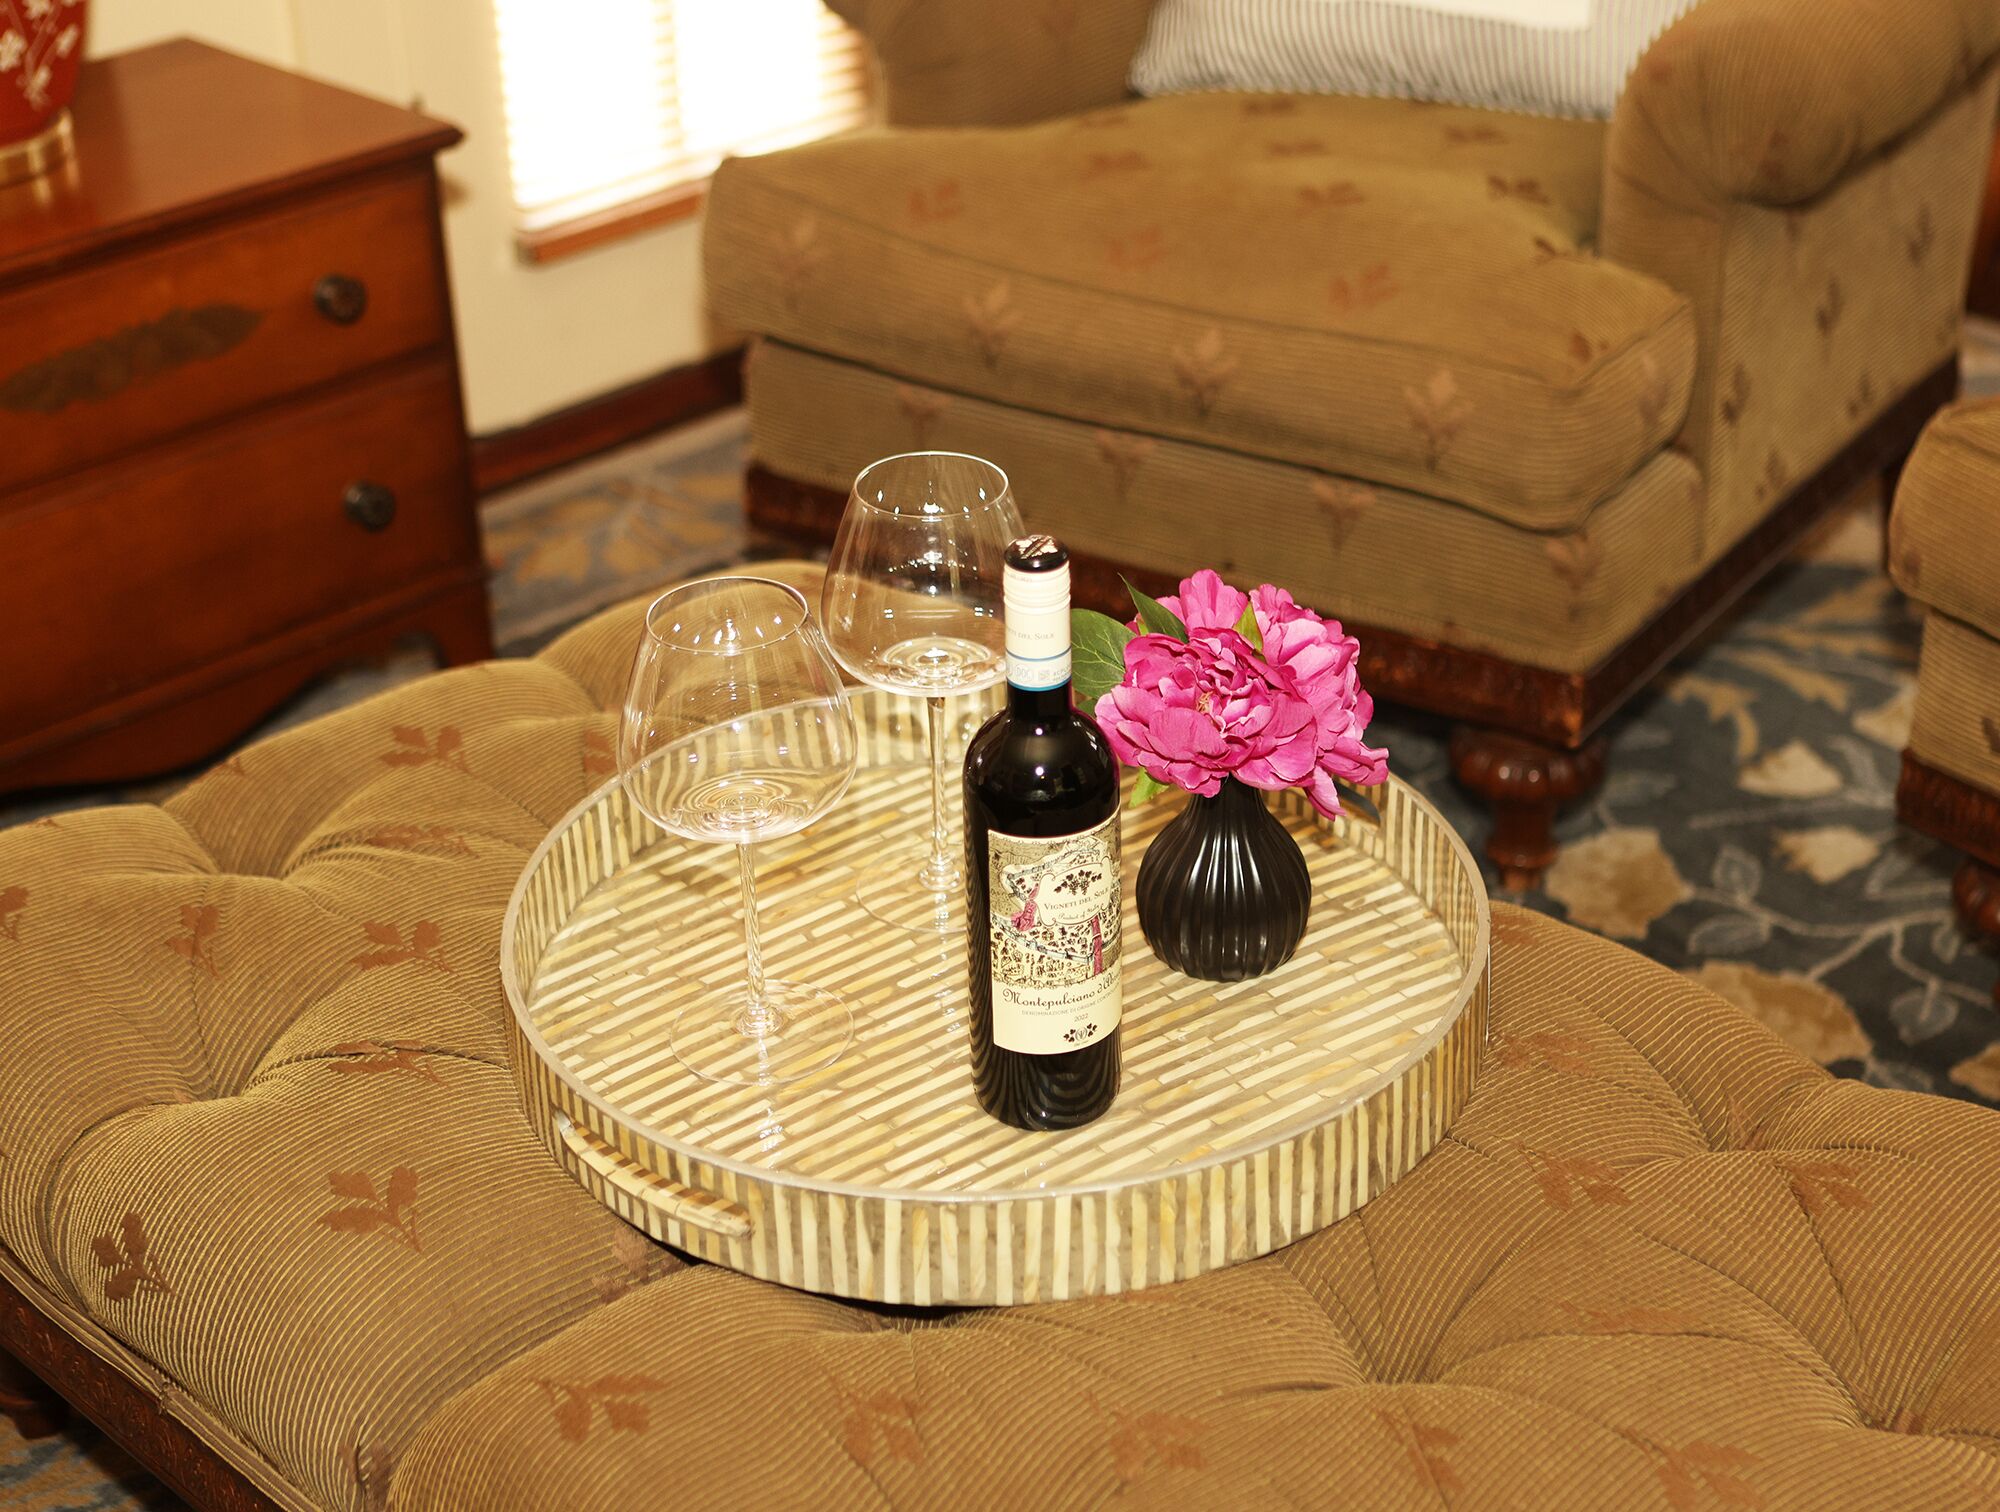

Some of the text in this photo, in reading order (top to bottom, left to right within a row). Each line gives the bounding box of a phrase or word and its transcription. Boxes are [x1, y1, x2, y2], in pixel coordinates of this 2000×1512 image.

[1044, 901, 1077, 910] VIGNETI
[1079, 897, 1091, 905] DEL
[1002, 988, 1095, 1010] Montepulciano
